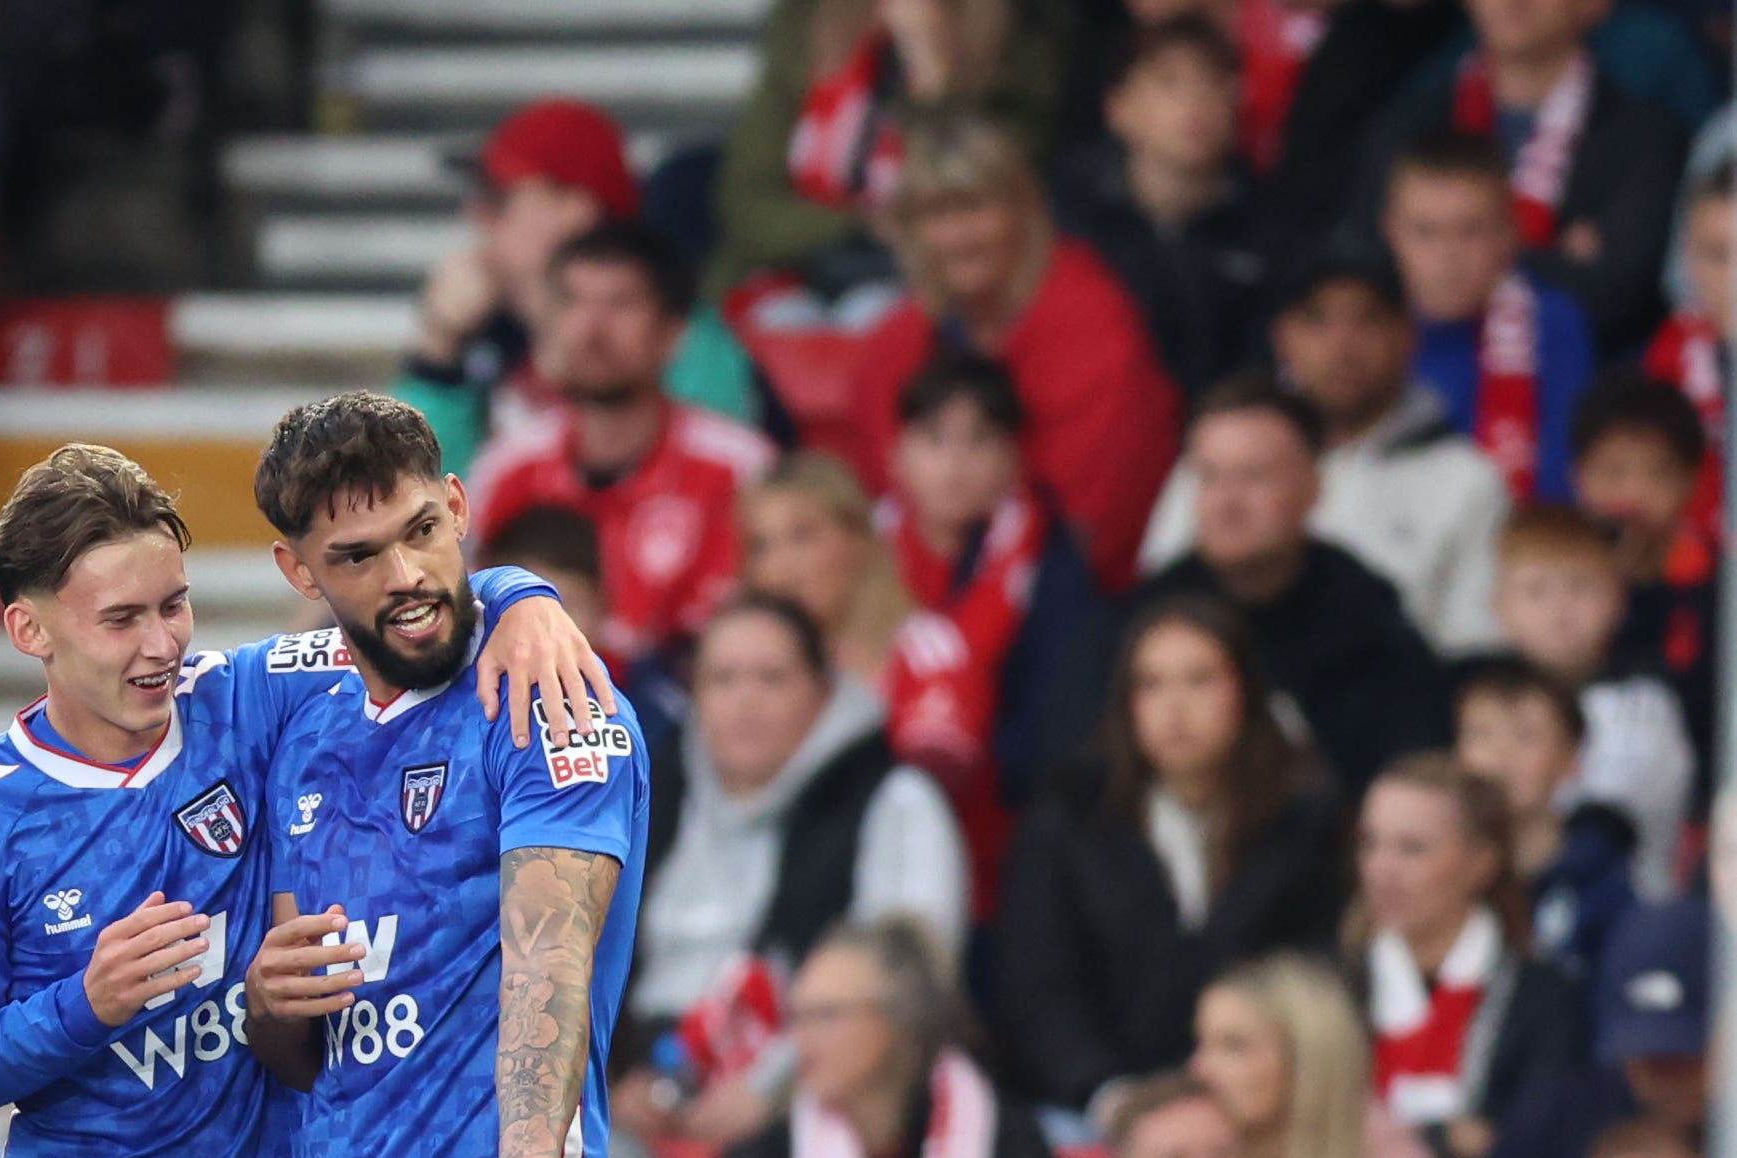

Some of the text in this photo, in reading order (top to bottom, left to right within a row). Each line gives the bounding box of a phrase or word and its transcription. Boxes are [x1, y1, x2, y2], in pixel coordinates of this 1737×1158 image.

[270, 632, 301, 669] Liv
[551, 751, 605, 783] Bet
[44, 913, 92, 936] hummel
